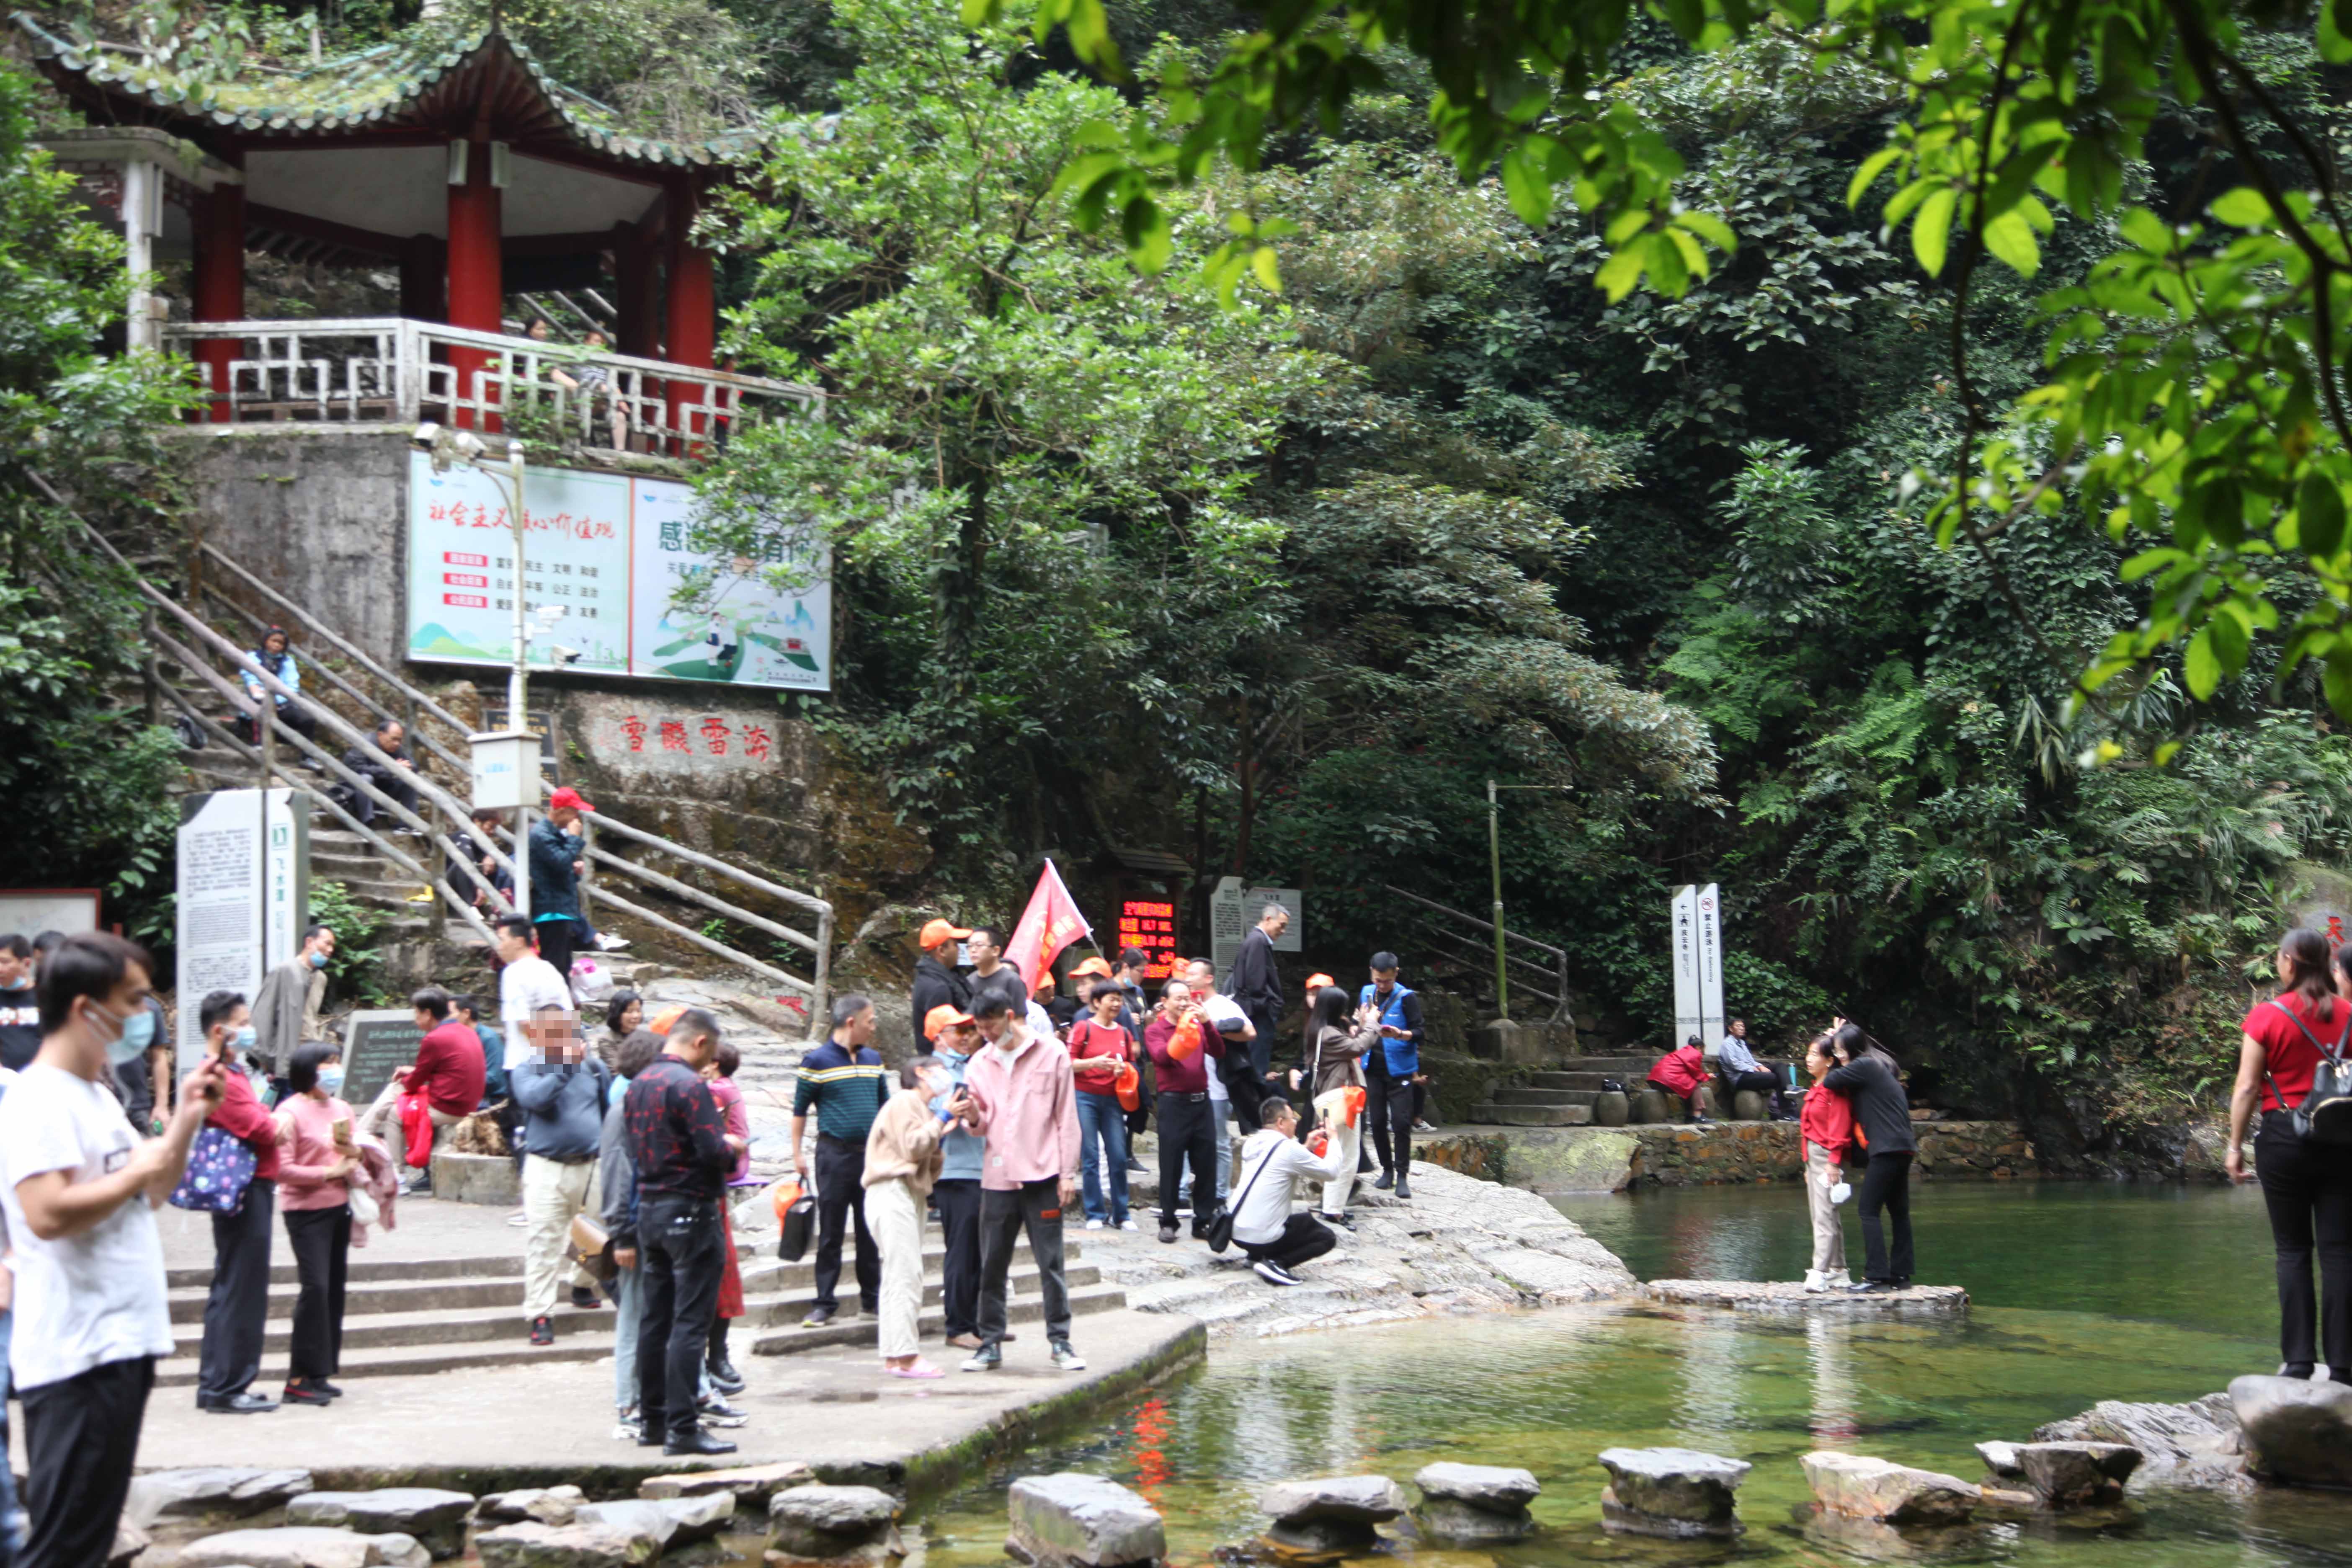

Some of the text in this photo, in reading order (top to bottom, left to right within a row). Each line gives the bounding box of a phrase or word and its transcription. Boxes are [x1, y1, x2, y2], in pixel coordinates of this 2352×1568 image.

[525, 560, 544, 572] 民主
[552, 564, 571, 575] 文明
[580, 566, 598, 578] 和谐
[525, 580, 543, 593] 平等
[552, 585, 570, 596] 公正
[580, 587, 598, 598] 法治
[580, 607, 598, 618] 友善
[1705, 913, 1713, 946] 禁止游泳
